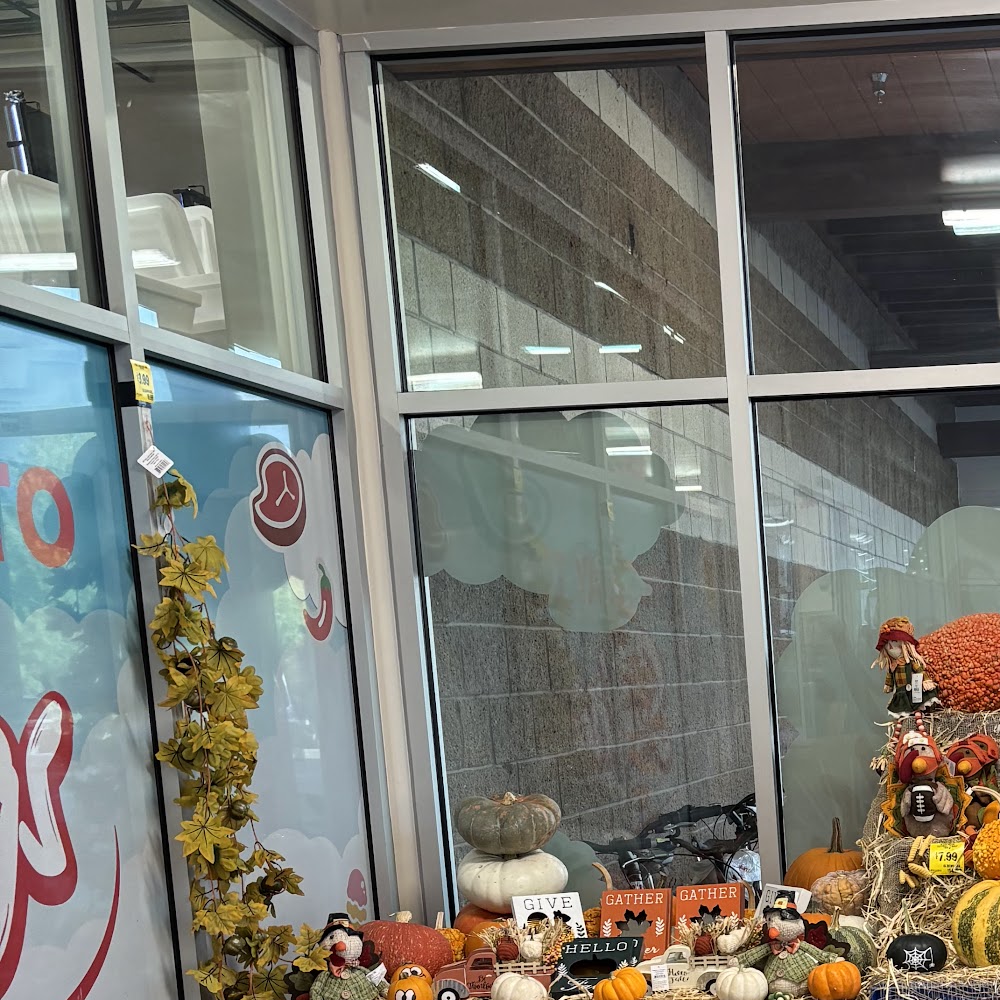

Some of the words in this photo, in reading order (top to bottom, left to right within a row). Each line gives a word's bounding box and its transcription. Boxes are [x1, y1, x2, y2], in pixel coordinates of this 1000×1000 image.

[605, 892, 664, 906] GATHER
[679, 886, 738, 902] GATHER
[523, 896, 574, 911] GIVE
[564, 941, 628, 955] HELLO
